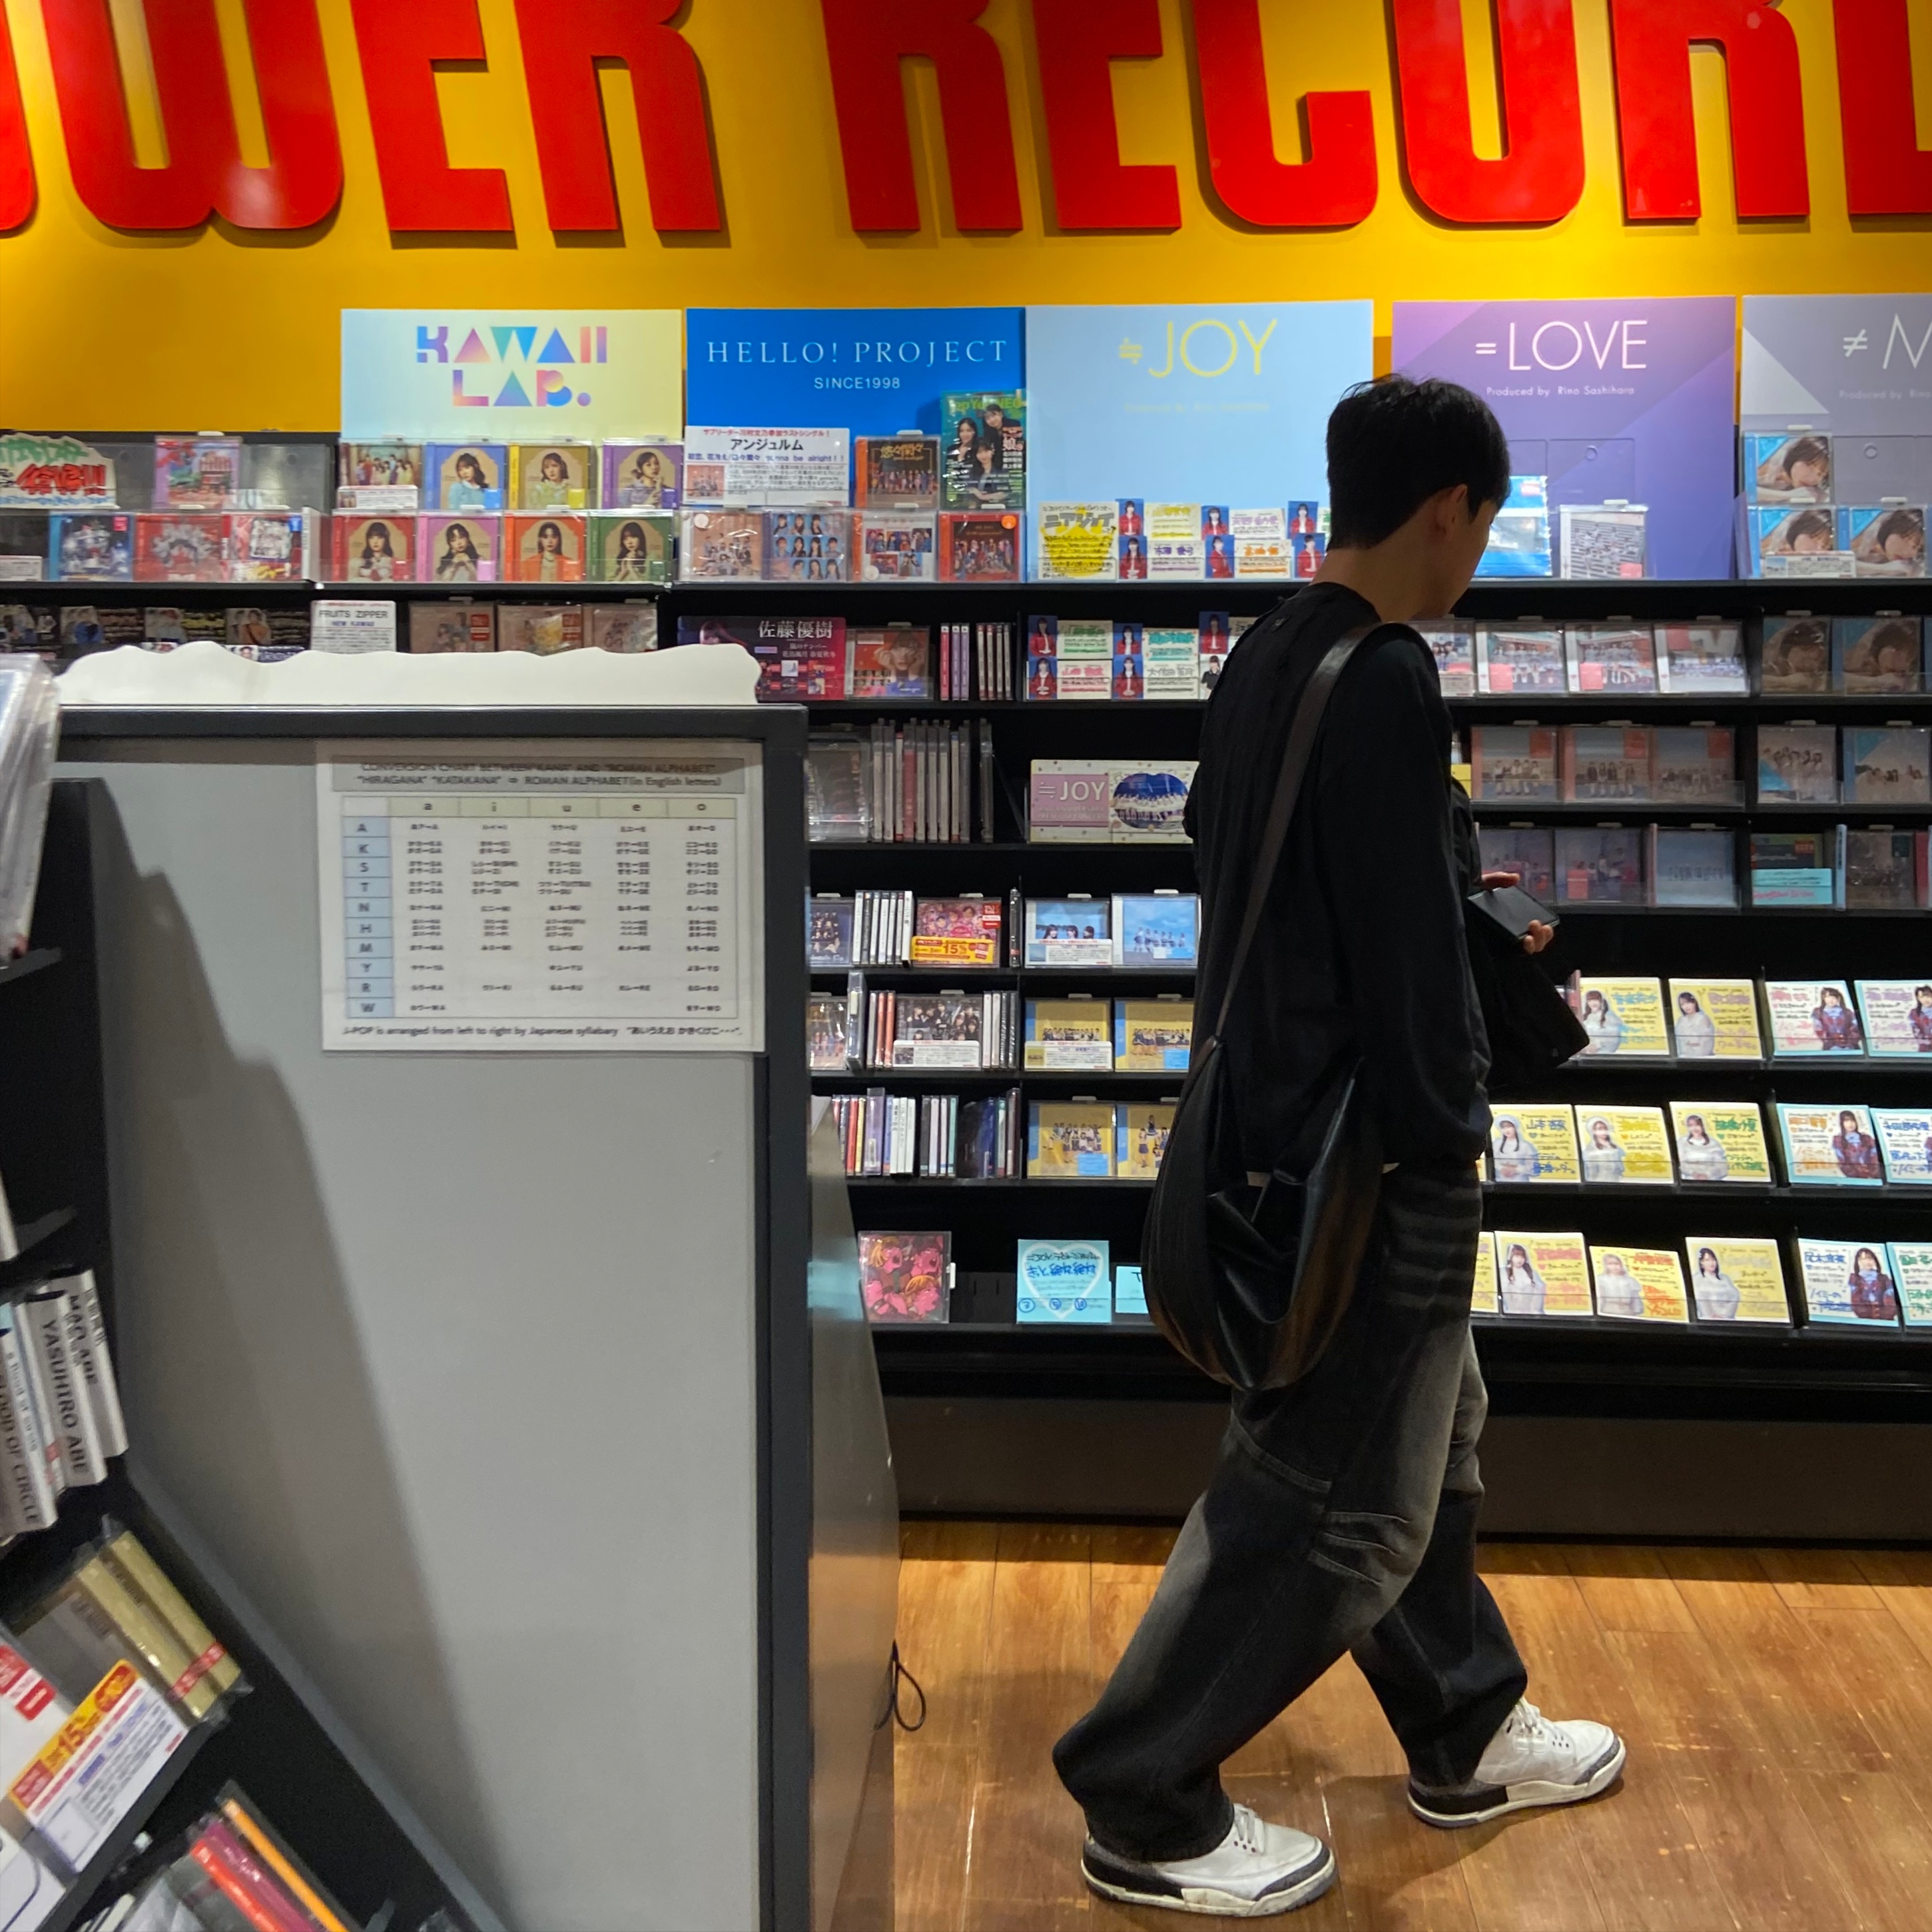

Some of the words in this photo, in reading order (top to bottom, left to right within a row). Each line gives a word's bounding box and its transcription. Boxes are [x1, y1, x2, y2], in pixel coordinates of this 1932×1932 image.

[416, 326, 607, 363] KAWAII
[707, 341, 838, 363] HELLO!
[854, 340, 1007, 367] PROJECT
[452, 370, 592, 407] LAB.
[814, 377, 900, 389] SINCE1998
[1486, 386, 1533, 396] Produced
[1537, 386, 1550, 398] by
[1558, 386, 1580, 396] Rino
[1584, 385, 1635, 395] Sashihara
[731, 438, 804, 451] アンジュルム
[319, 609, 351, 619] FRUITS
[355, 610, 388, 619] ZIPPER
[757, 620, 834, 639] 佐藤優樹
[524, 776, 568, 785] ROMAN
[645, 777, 683, 788] English
[631, 803, 641, 812] e
[357, 822, 368, 832] A
[358, 844, 370, 854] K
[359, 862, 369, 872] S
[360, 882, 370, 892] T
[358, 902, 370, 912] N
[360, 924, 372, 933] H
[360, 943, 373, 953] M
[362, 963, 372, 973] Y
[43, 1319, 79, 1430] YASUHIRO
[67, 1437, 90, 1476] ABE
[5, 1436, 22, 1456] OF
[13, 1463, 39, 1525] CIRCLE
